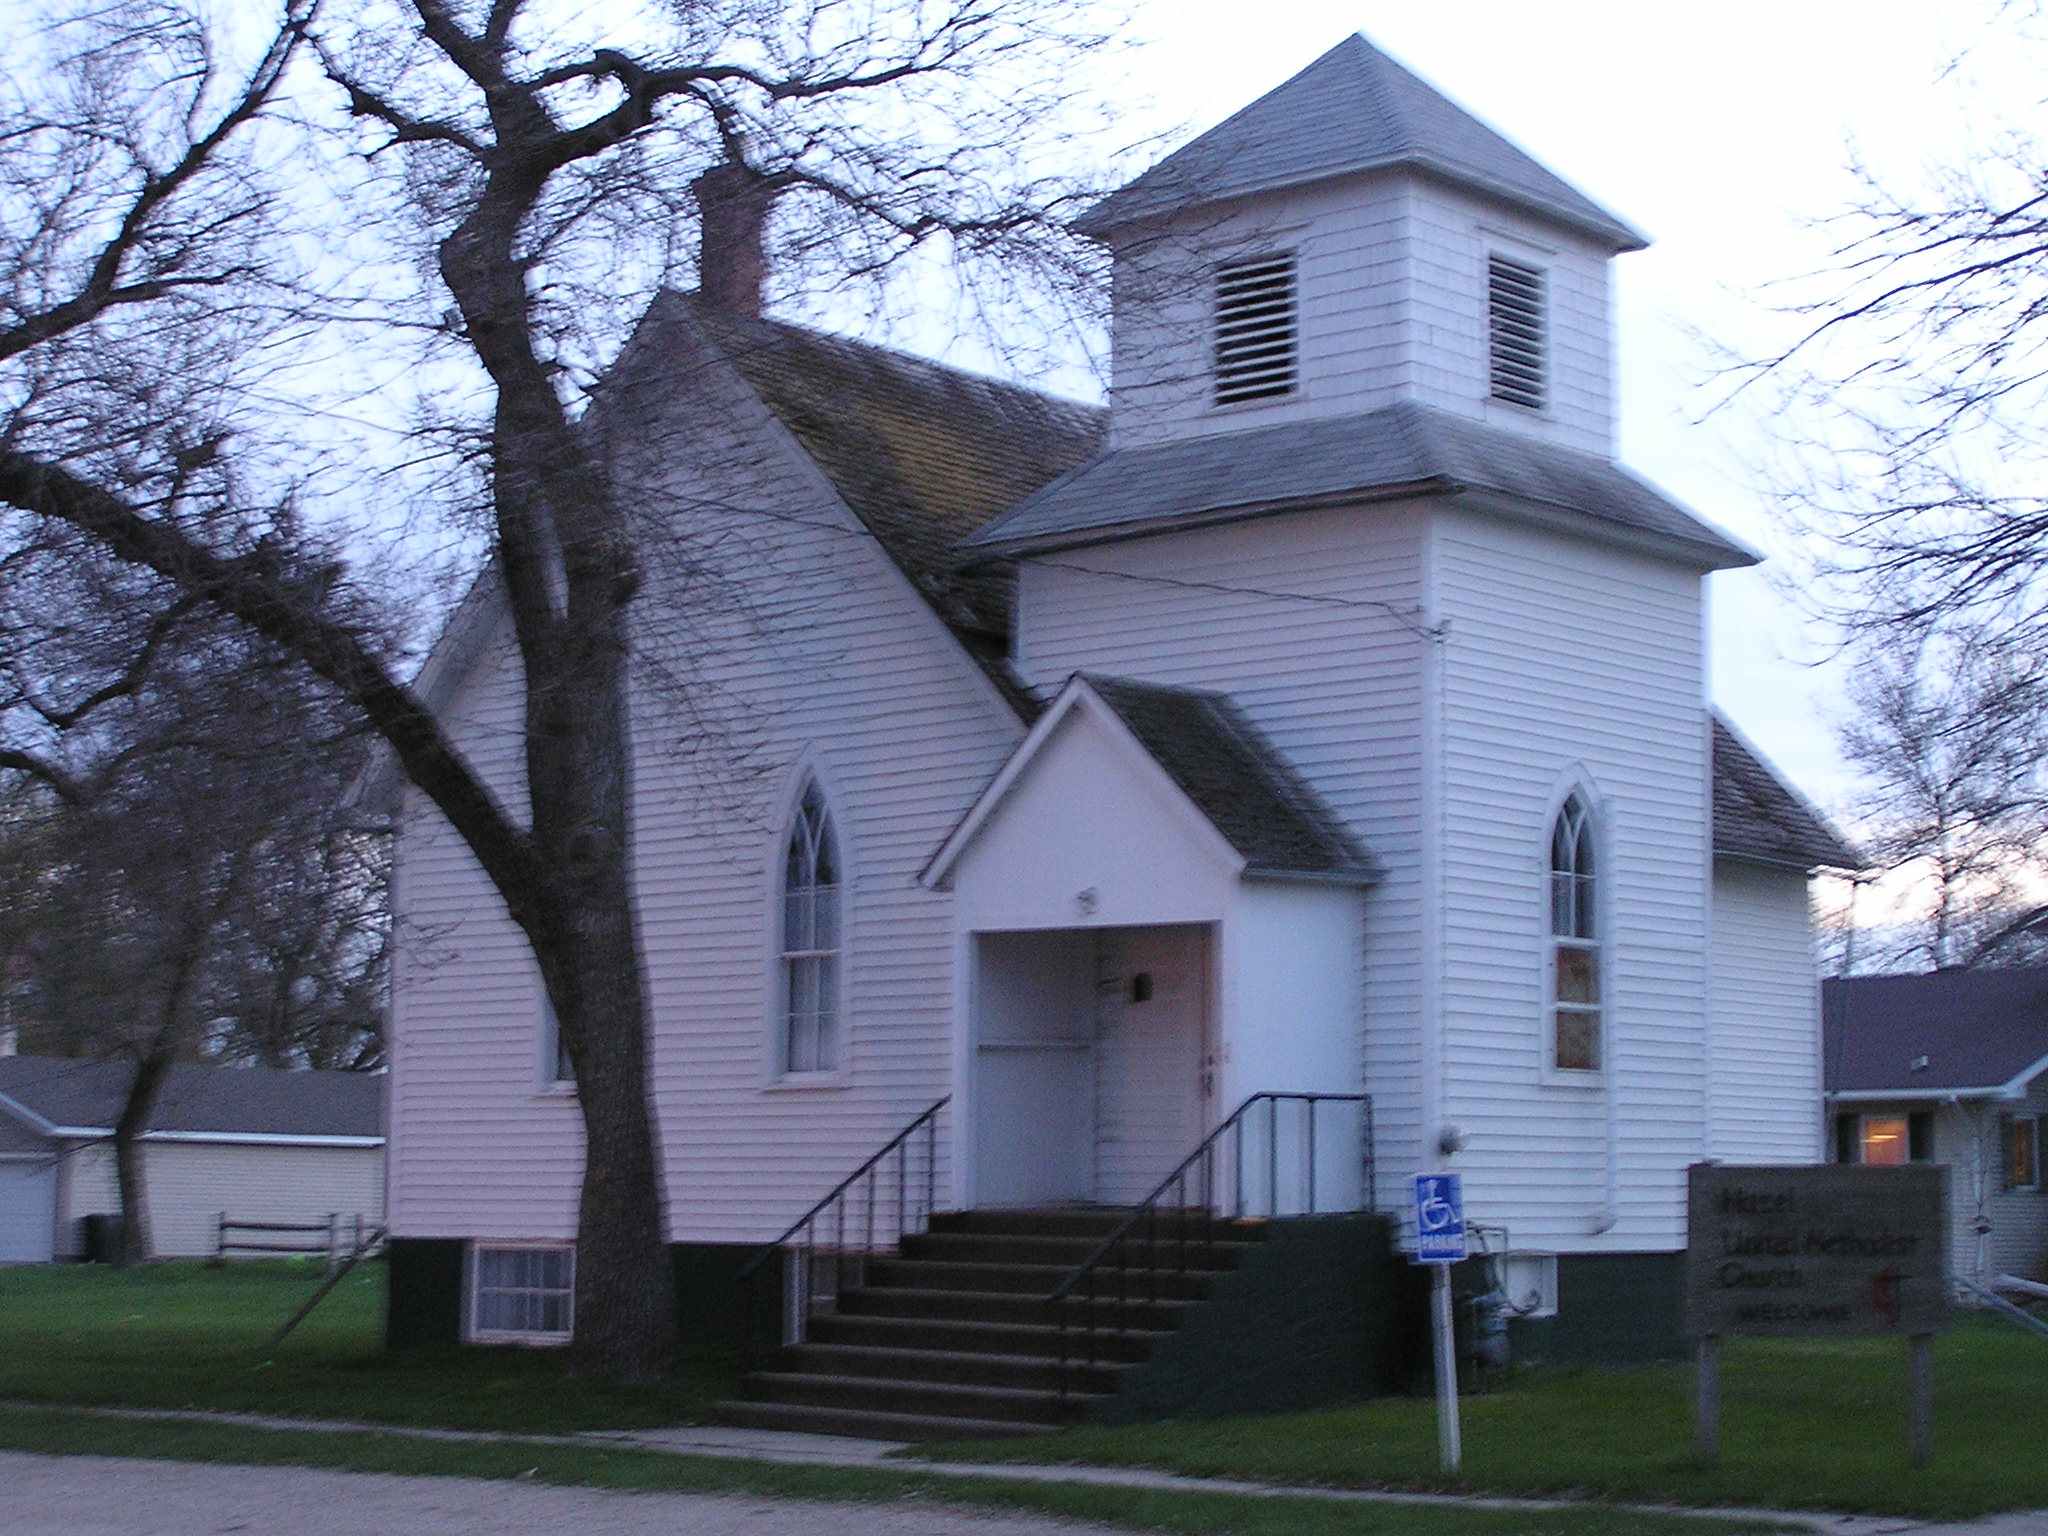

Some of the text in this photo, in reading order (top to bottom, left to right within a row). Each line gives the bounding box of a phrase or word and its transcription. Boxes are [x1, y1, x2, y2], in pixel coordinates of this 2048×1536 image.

[1720, 1186, 1794, 1214] Hazel
[1422, 1234, 1464, 1250] PARKING
[1720, 1228, 1920, 1257] United Methodist
[1720, 1262, 1803, 1288] Church
[1737, 1303, 1851, 1322] WELCOME
